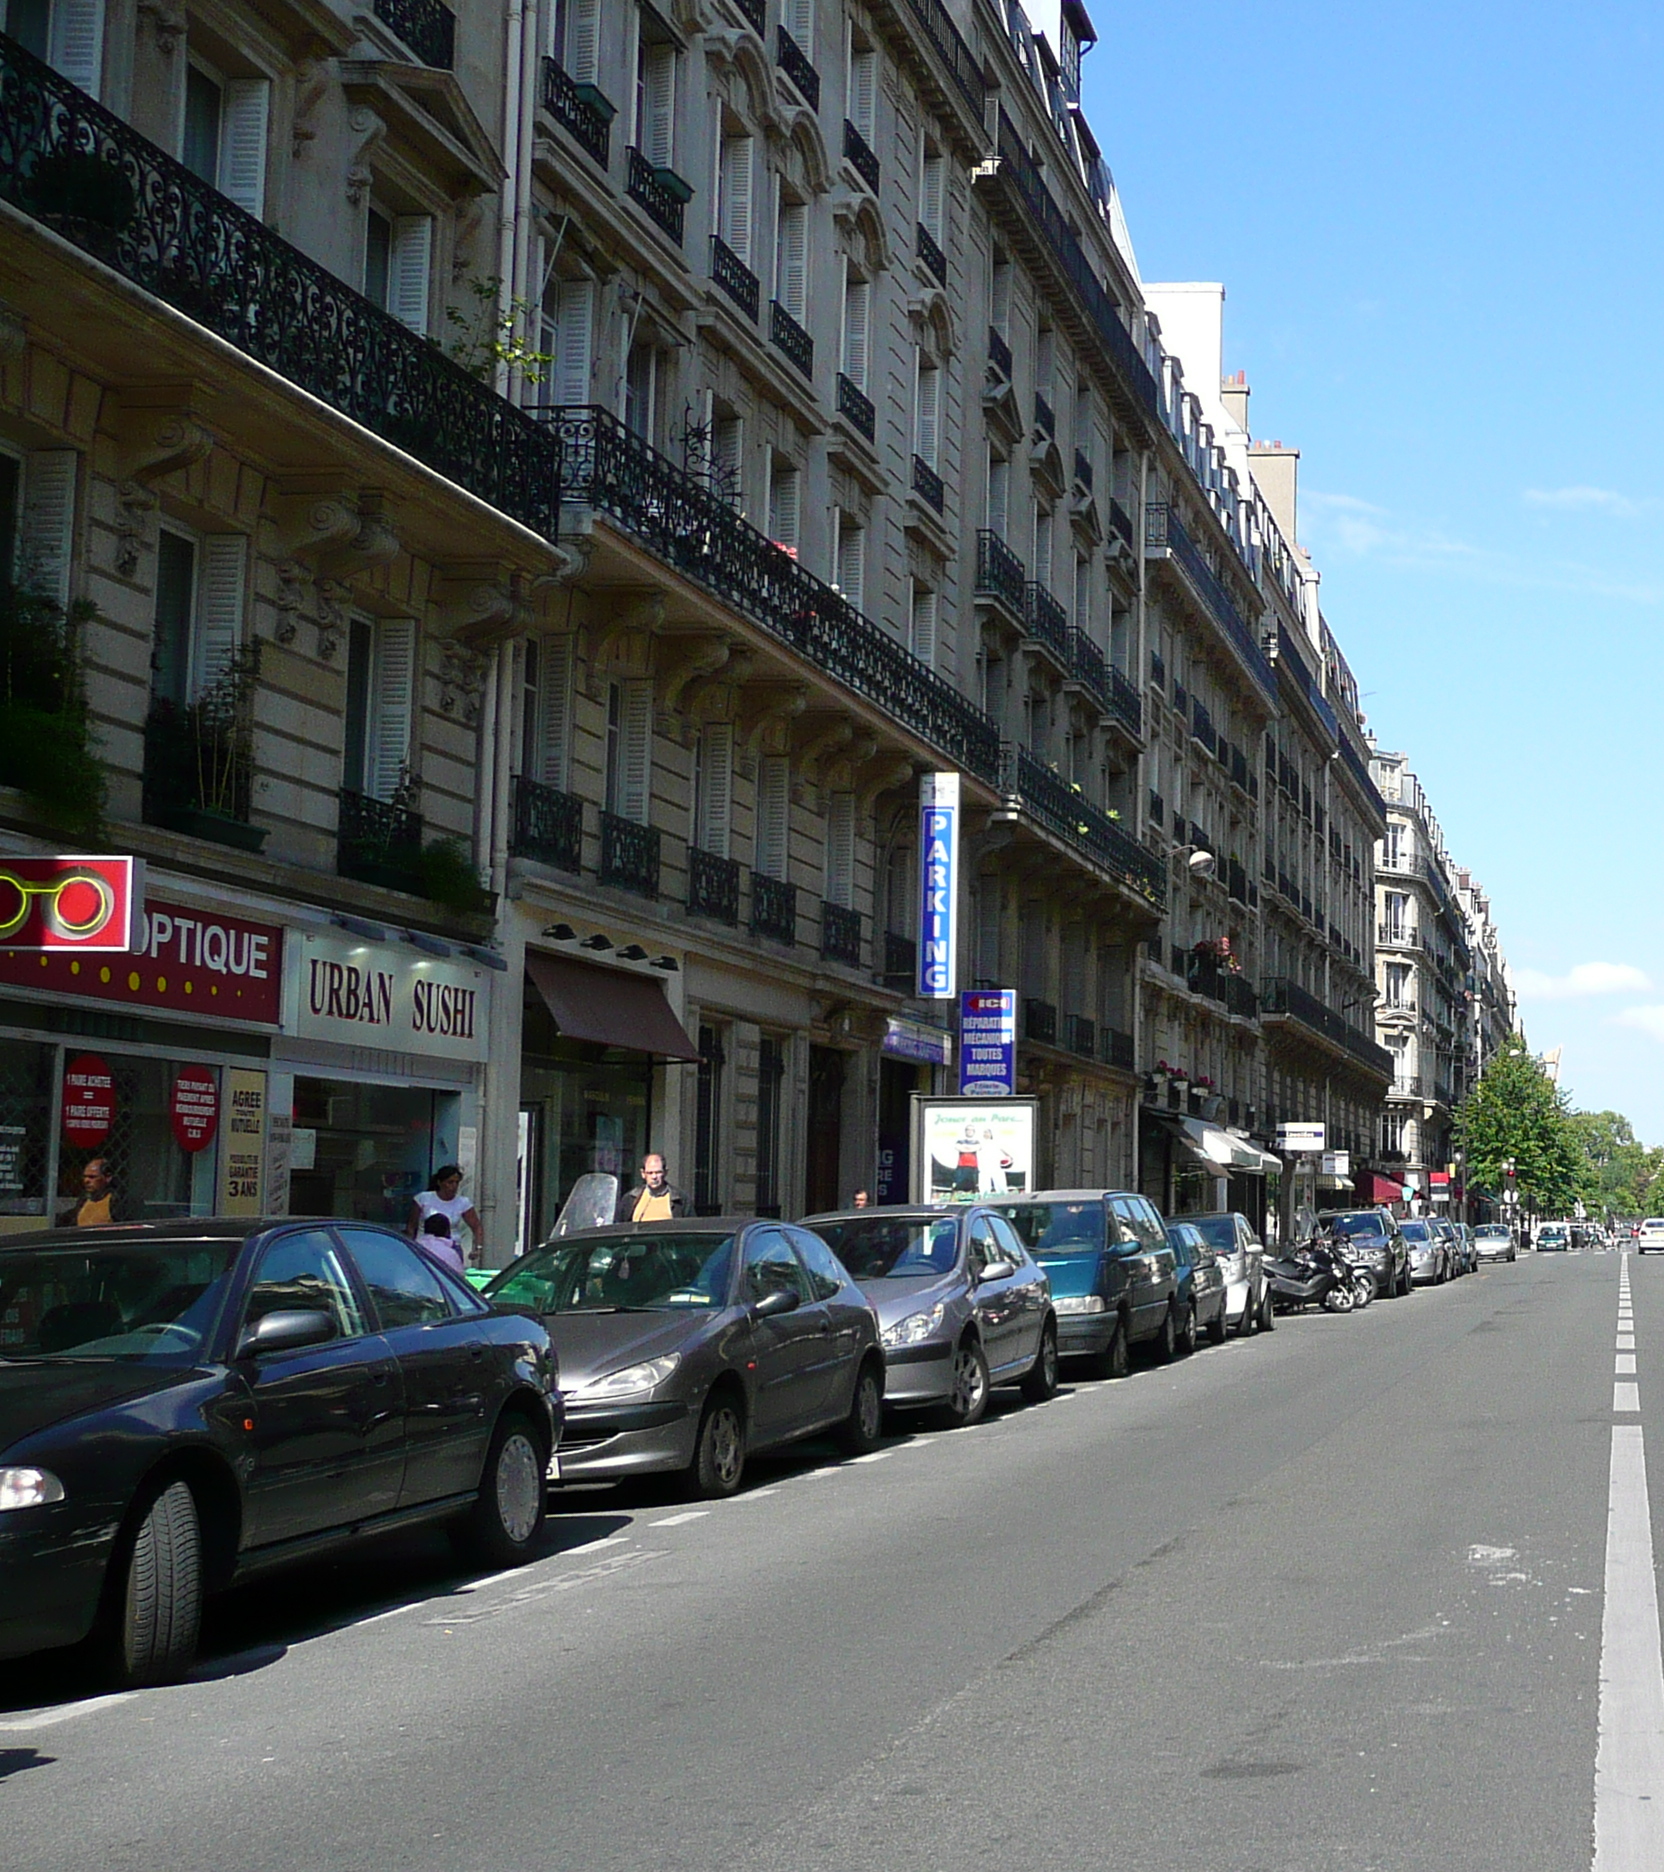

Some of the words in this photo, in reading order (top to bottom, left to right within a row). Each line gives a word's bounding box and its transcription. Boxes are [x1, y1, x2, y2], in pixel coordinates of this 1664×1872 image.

[925, 815, 949, 989] PARKING
[309, 958, 394, 1027] URBAN
[412, 979, 476, 1040] SUSHI
[979, 998, 1007, 1008] ICI
[963, 1016, 1012, 1029] RÉPARATI
[971, 1048, 1003, 1060] TOUTES
[967, 1063, 1007, 1077] MARQUES
[228, 1180, 239, 1197] 3
[240, 1181, 258, 1198] ANS
